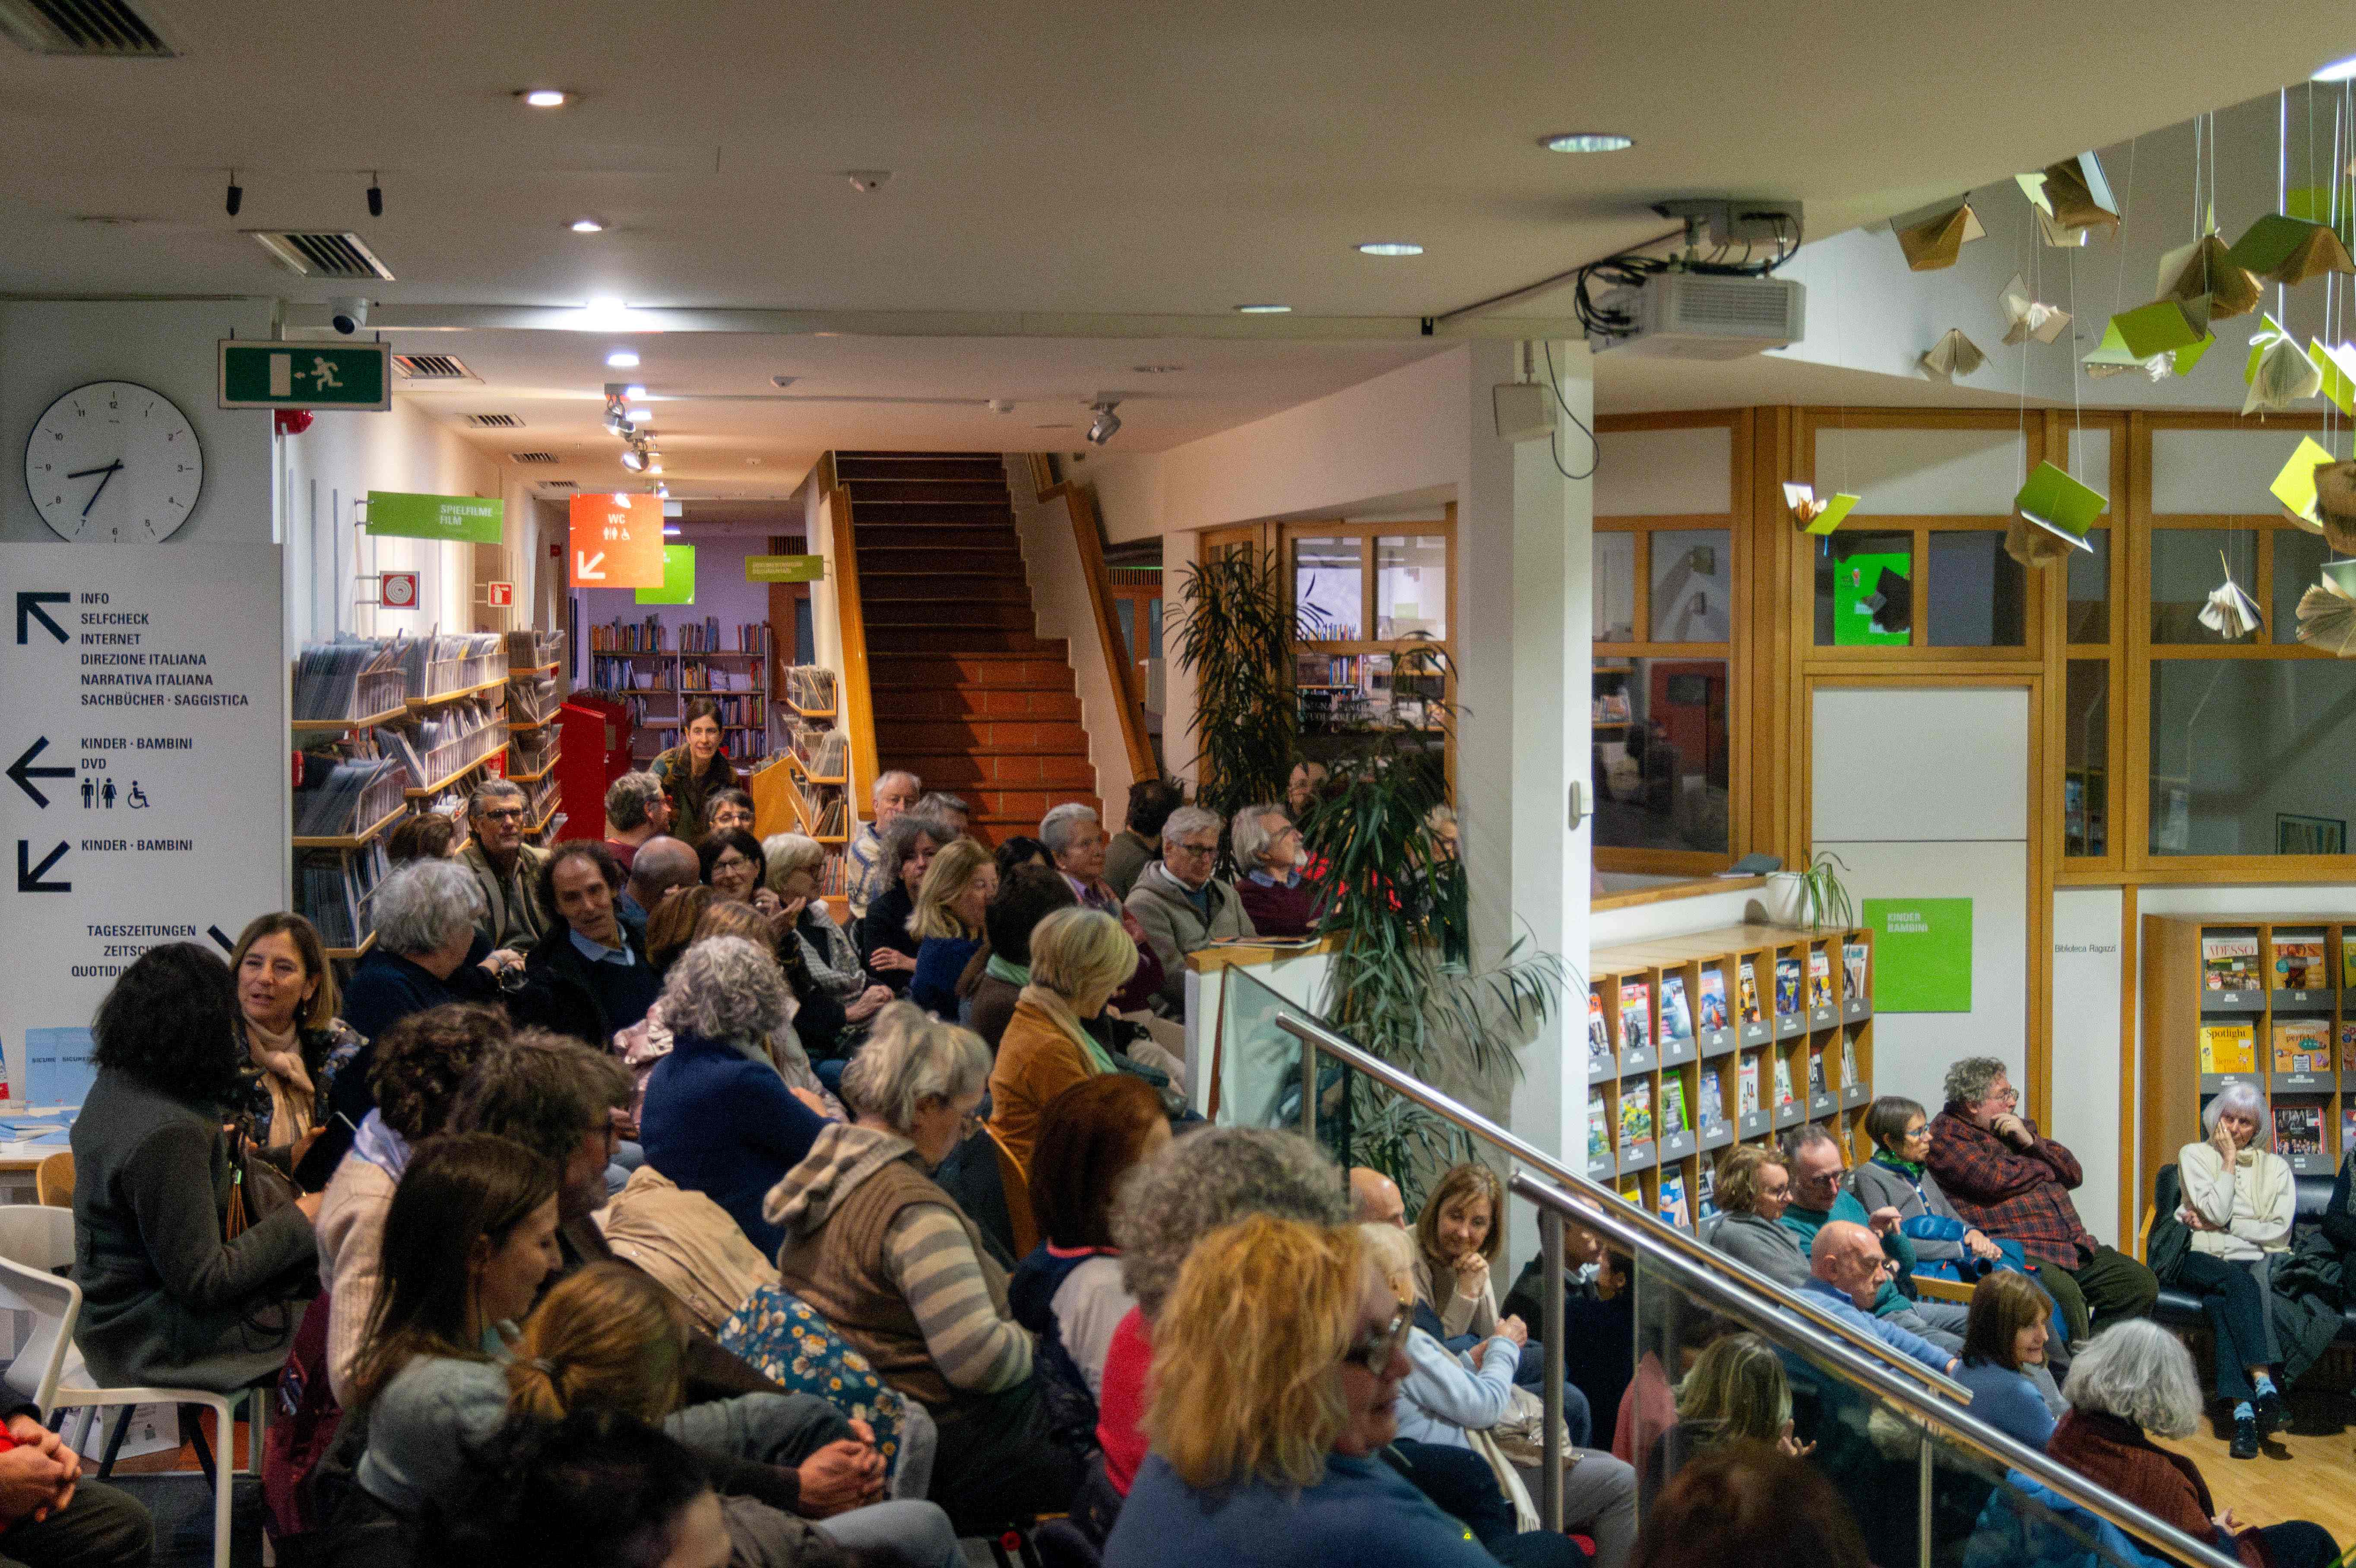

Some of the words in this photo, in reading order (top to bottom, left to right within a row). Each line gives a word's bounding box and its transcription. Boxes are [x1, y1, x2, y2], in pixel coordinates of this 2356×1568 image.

[440, 515, 462, 525] FILM
[608, 514, 625, 524] WC
[81, 593, 109, 604] INFO
[81, 613, 149, 625] SELFCHECK
[81, 633, 140, 645] INTERNET
[81, 654, 145, 665] DIREZIONE
[149, 654, 206, 665] ITALIANA
[81, 674, 152, 685] NARRATIVA
[156, 674, 213, 686] ITALIANA
[81, 692, 164, 706] SACHBÜCHER
[174, 694, 248, 706] SAGGISTICA
[81, 738, 127, 749] KINDER
[137, 738, 192, 749] BAMBINI
[81, 758, 106, 769] DVD
[82, 840, 127, 851] KINDER
[137, 840, 192, 851] BAMBINI
[87, 925, 196, 936] TAGESZEITUNGEN
[2089, 944, 2116, 954] Ragazzi
[2210, 945, 2254, 955] ADESSO
[2206, 1028, 2246, 1039] Spotlight
